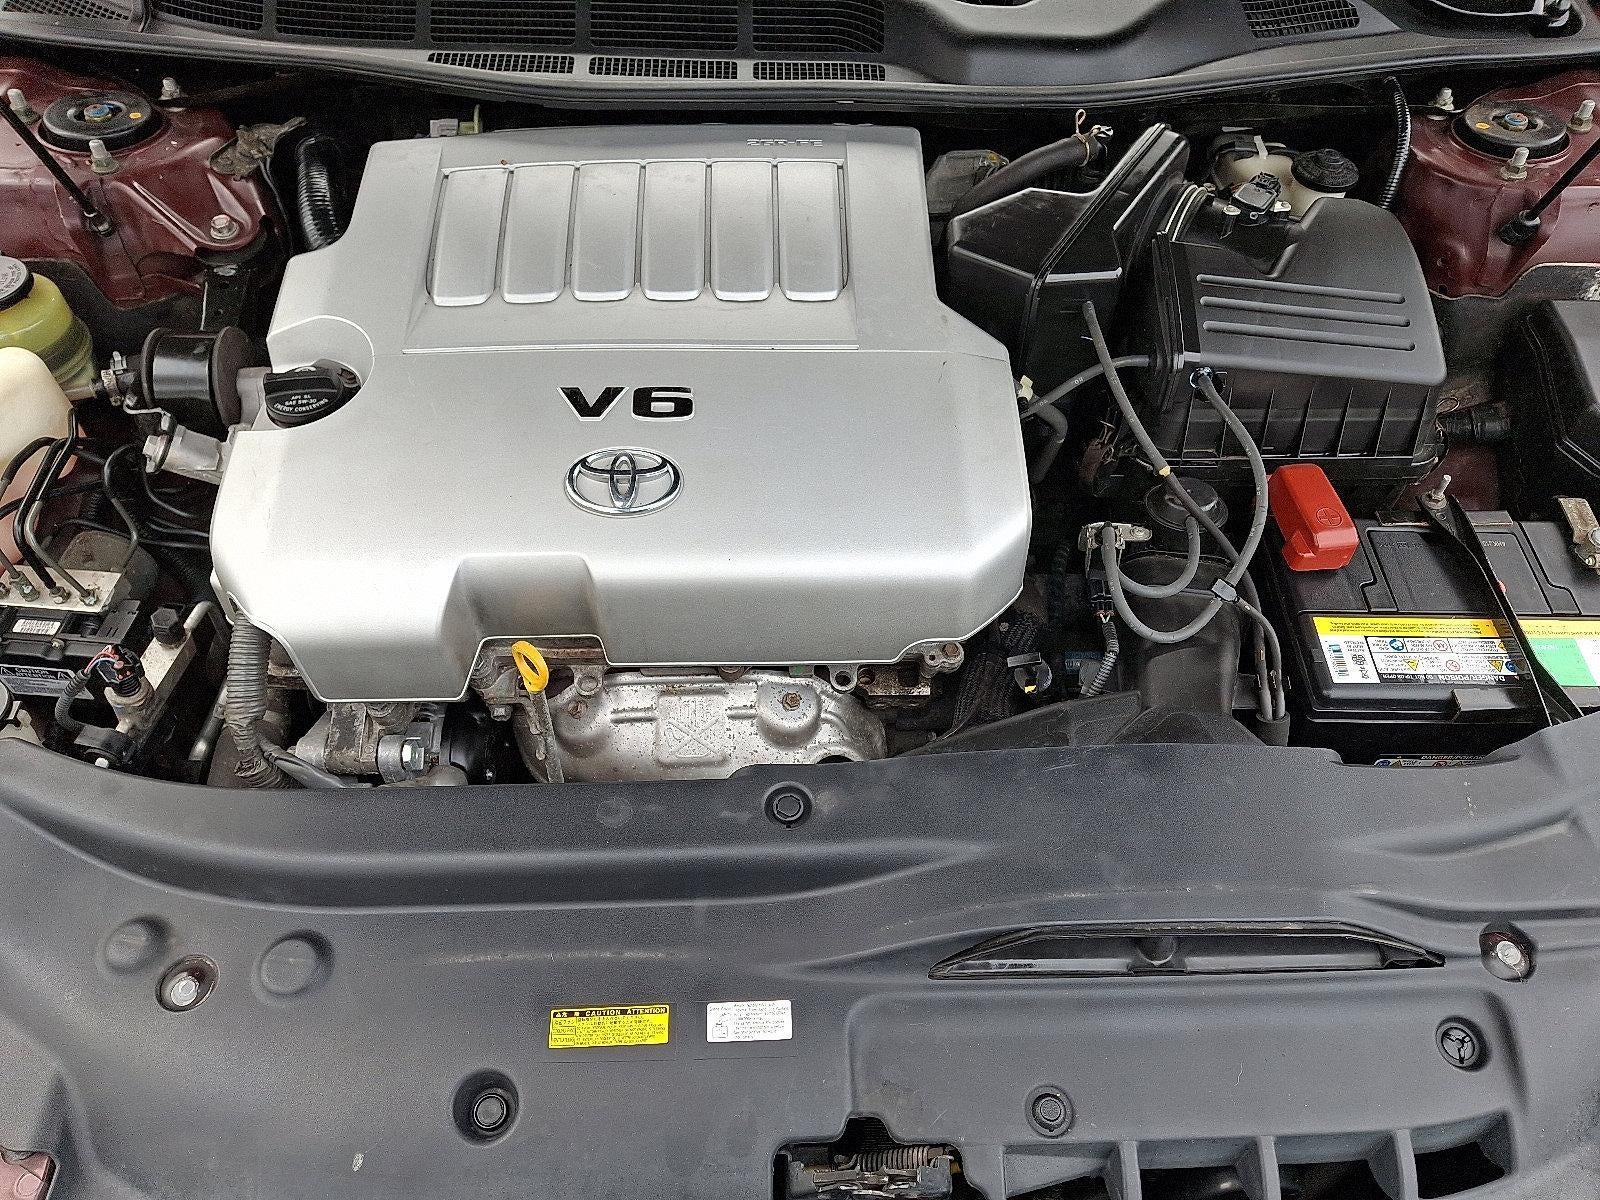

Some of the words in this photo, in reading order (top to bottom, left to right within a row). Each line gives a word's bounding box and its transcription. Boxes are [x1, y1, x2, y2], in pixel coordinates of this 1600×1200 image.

[273, 402, 293, 412] ENERGY
[294, 398, 329, 412] CONSERVING
[556, 385, 695, 422] V6
[626, 1007, 666, 1015] ATTENTION
